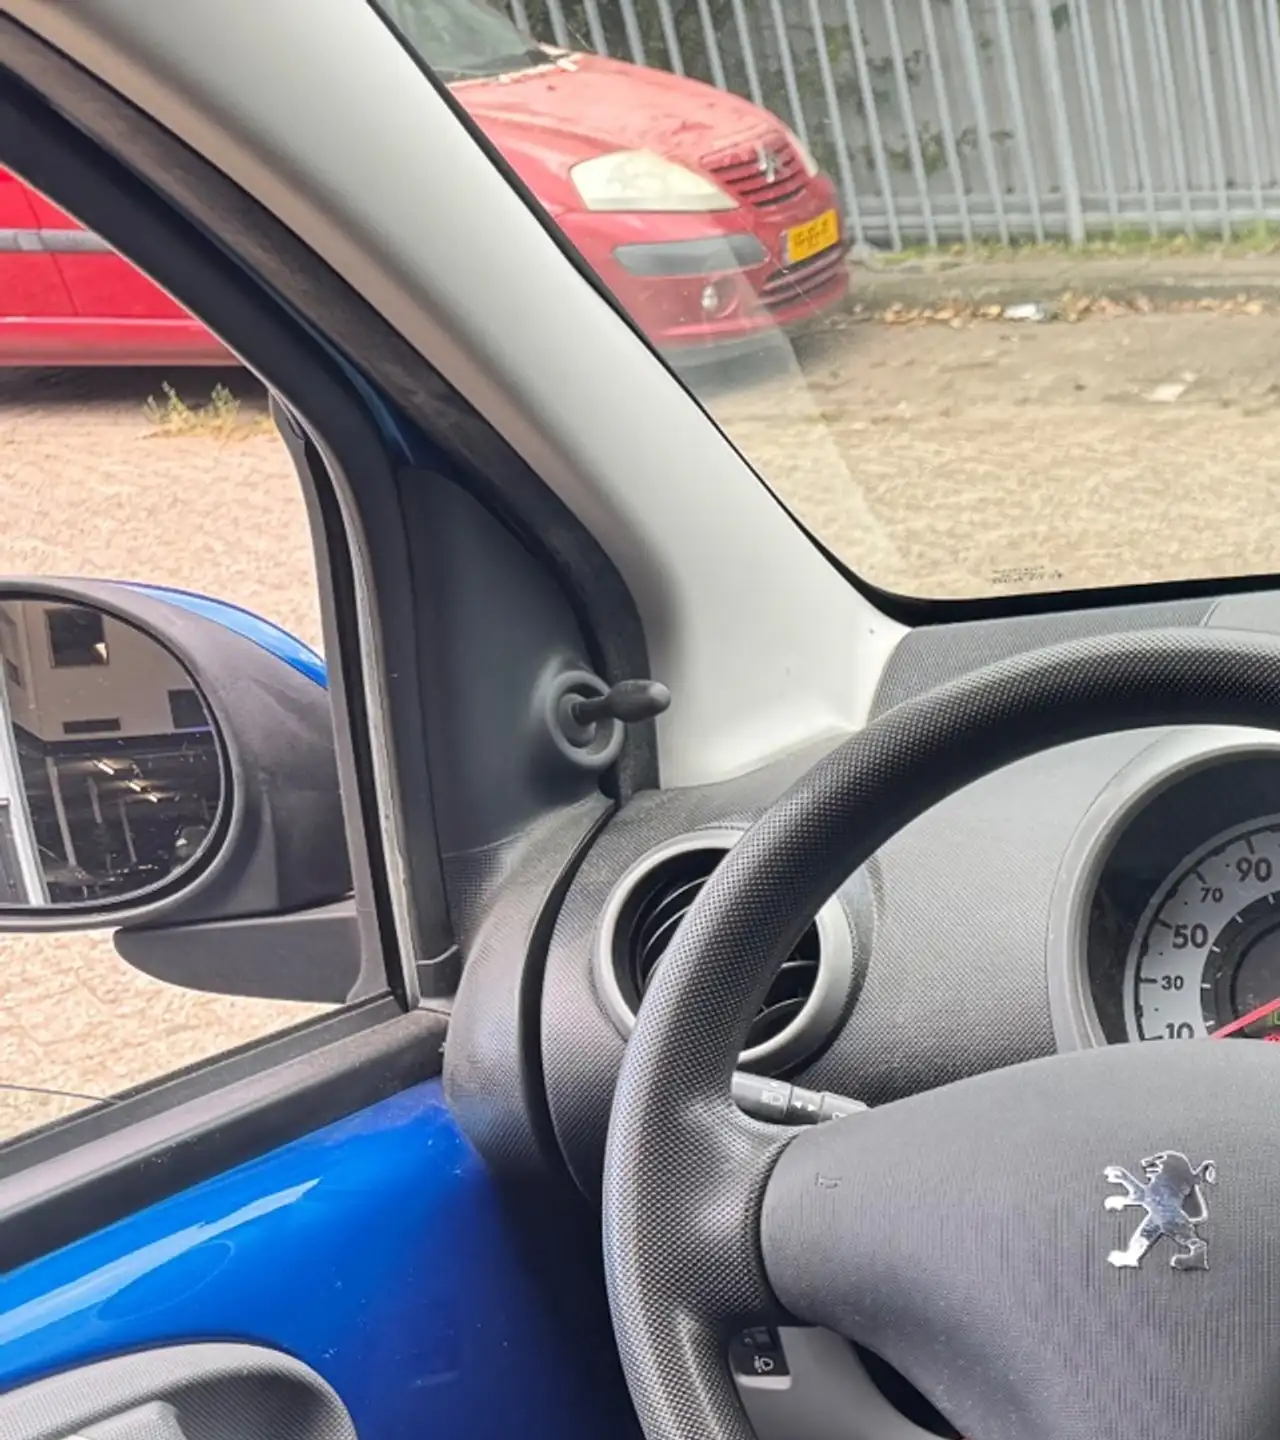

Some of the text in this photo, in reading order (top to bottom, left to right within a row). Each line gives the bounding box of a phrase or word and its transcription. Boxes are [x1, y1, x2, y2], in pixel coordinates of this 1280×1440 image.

[1235, 856, 1273, 883] 90
[1200, 887, 1224, 904] 70
[1172, 923, 1209, 950] 50
[1161, 975, 1185, 991] 30
[1165, 1022, 1195, 1039] 10
